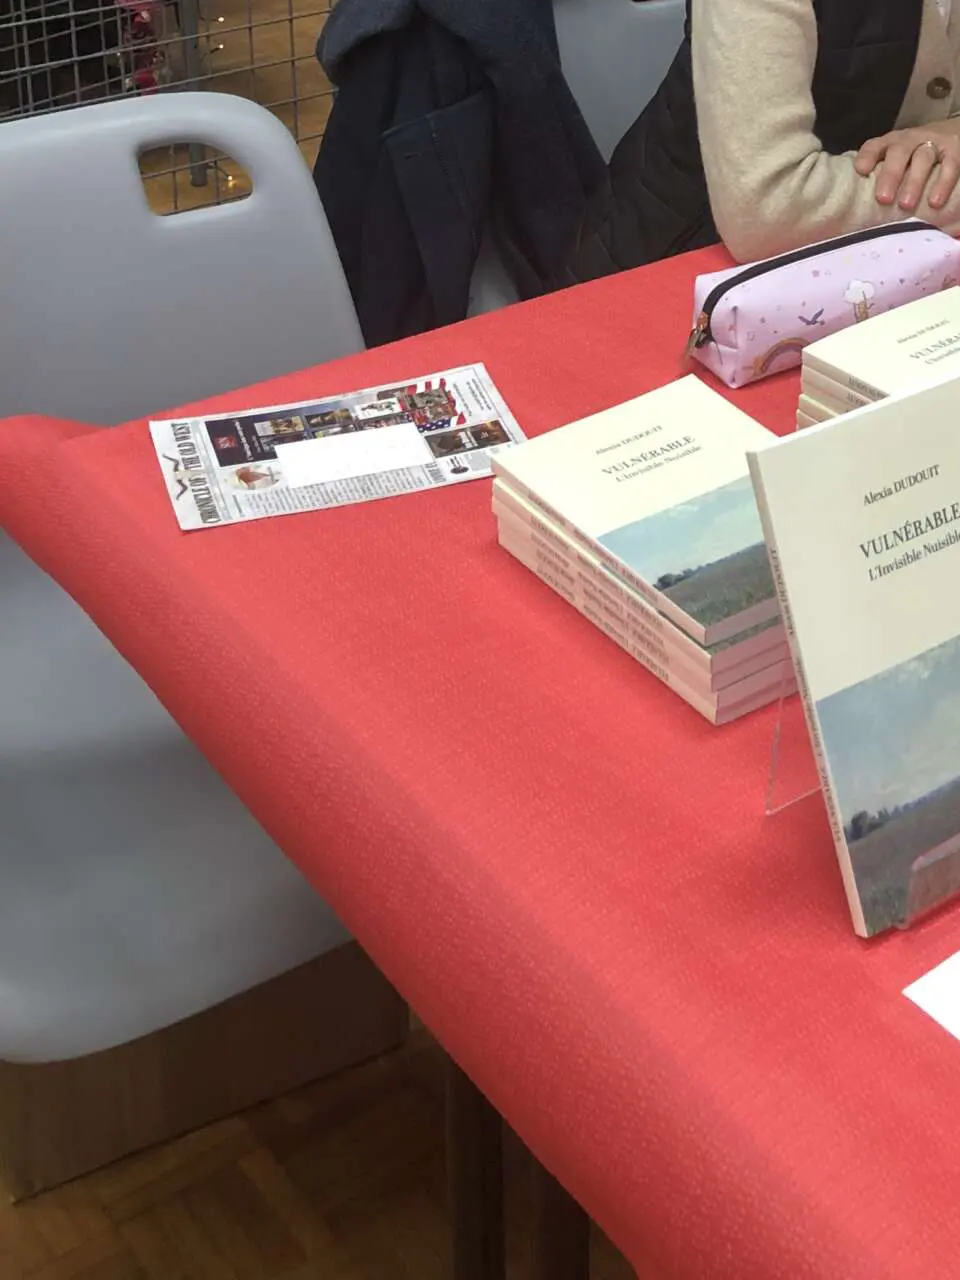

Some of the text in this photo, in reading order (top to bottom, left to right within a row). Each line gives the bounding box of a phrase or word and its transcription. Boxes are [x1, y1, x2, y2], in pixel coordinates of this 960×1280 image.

[171, 422, 192, 442] WEST
[177, 441, 198, 456] OLD
[181, 455, 202, 470] THE
[601, 435, 696, 474] VULNÉRABLE
[863, 464, 941, 508] Alexia DUDOUIT
[867, 545, 923, 582] L'Invisible
